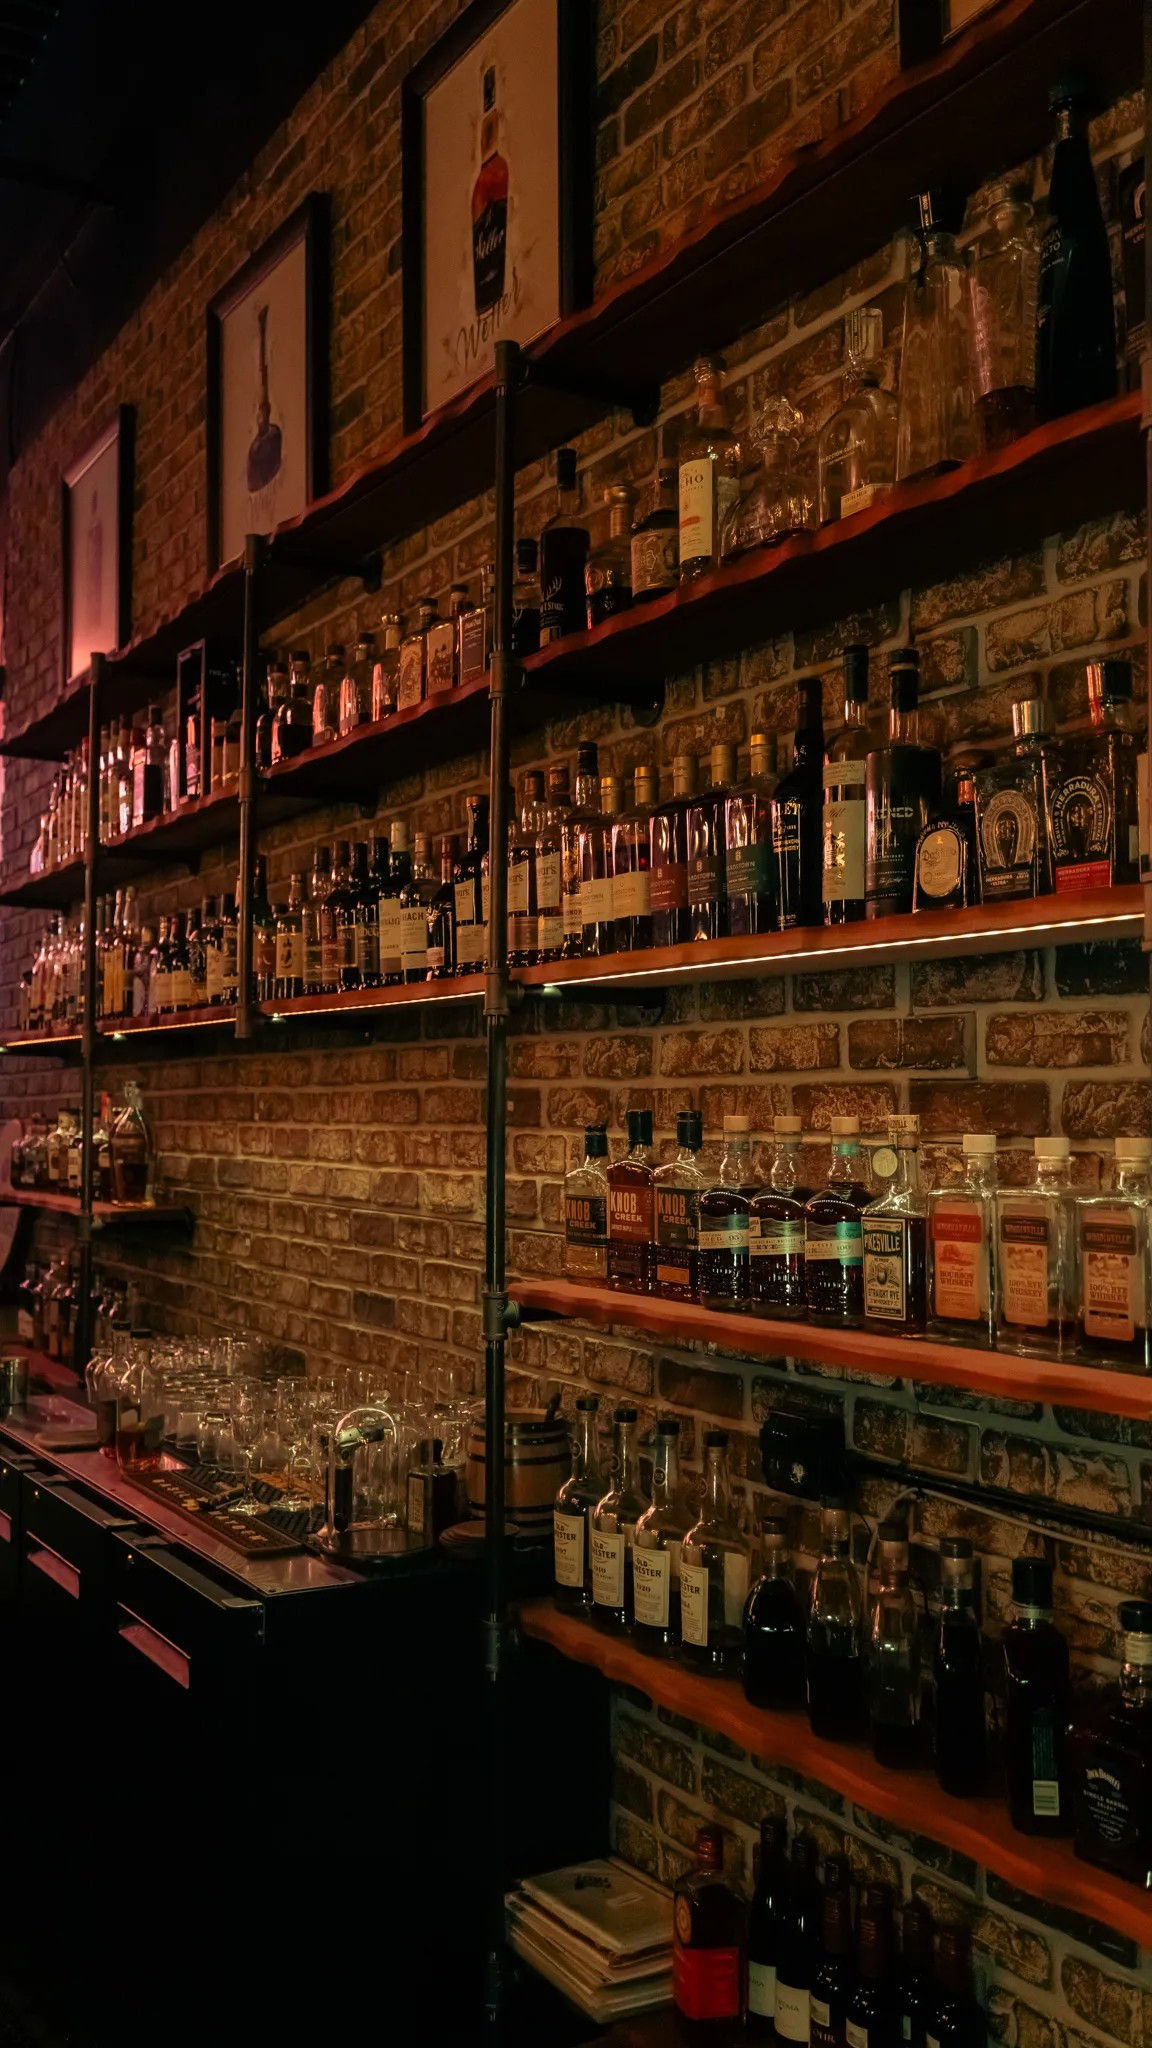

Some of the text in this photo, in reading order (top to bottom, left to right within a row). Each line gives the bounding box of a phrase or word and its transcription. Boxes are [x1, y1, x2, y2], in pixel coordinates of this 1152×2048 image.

[566, 1199, 591, 1220] KNOB
[610, 1190, 637, 1213] KNOB
[658, 1192, 686, 1216] KNOB
[569, 1220, 597, 1230] CREEK
[614, 1212, 643, 1223] CREEK
[662, 1215, 692, 1225] CREEK
